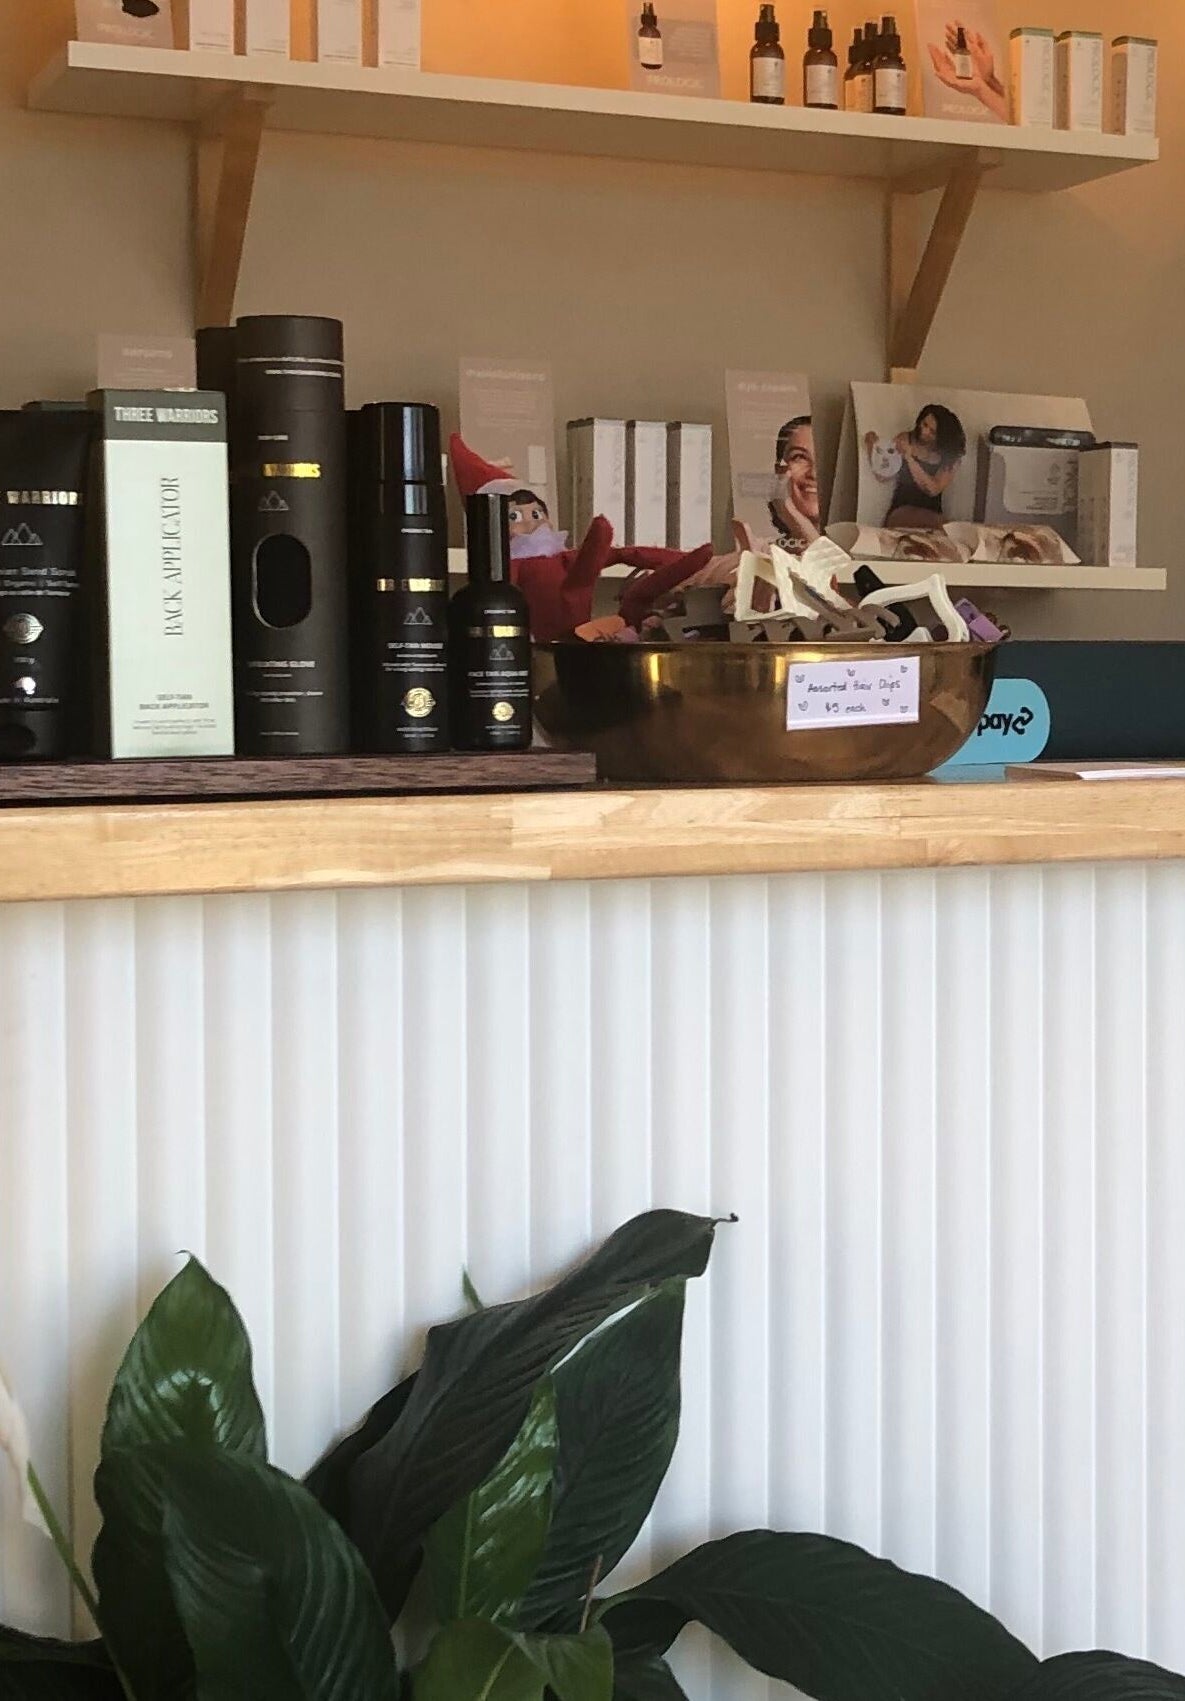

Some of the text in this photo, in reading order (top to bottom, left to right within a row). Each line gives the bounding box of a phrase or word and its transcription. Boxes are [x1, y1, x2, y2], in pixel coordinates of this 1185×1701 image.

[114, 406, 219, 424] THREE WARRIORS
[160, 477, 184, 636] BACK APPLICATOR
[807, 682, 847, 693] Assorted
[825, 702, 866, 713] $5 each
